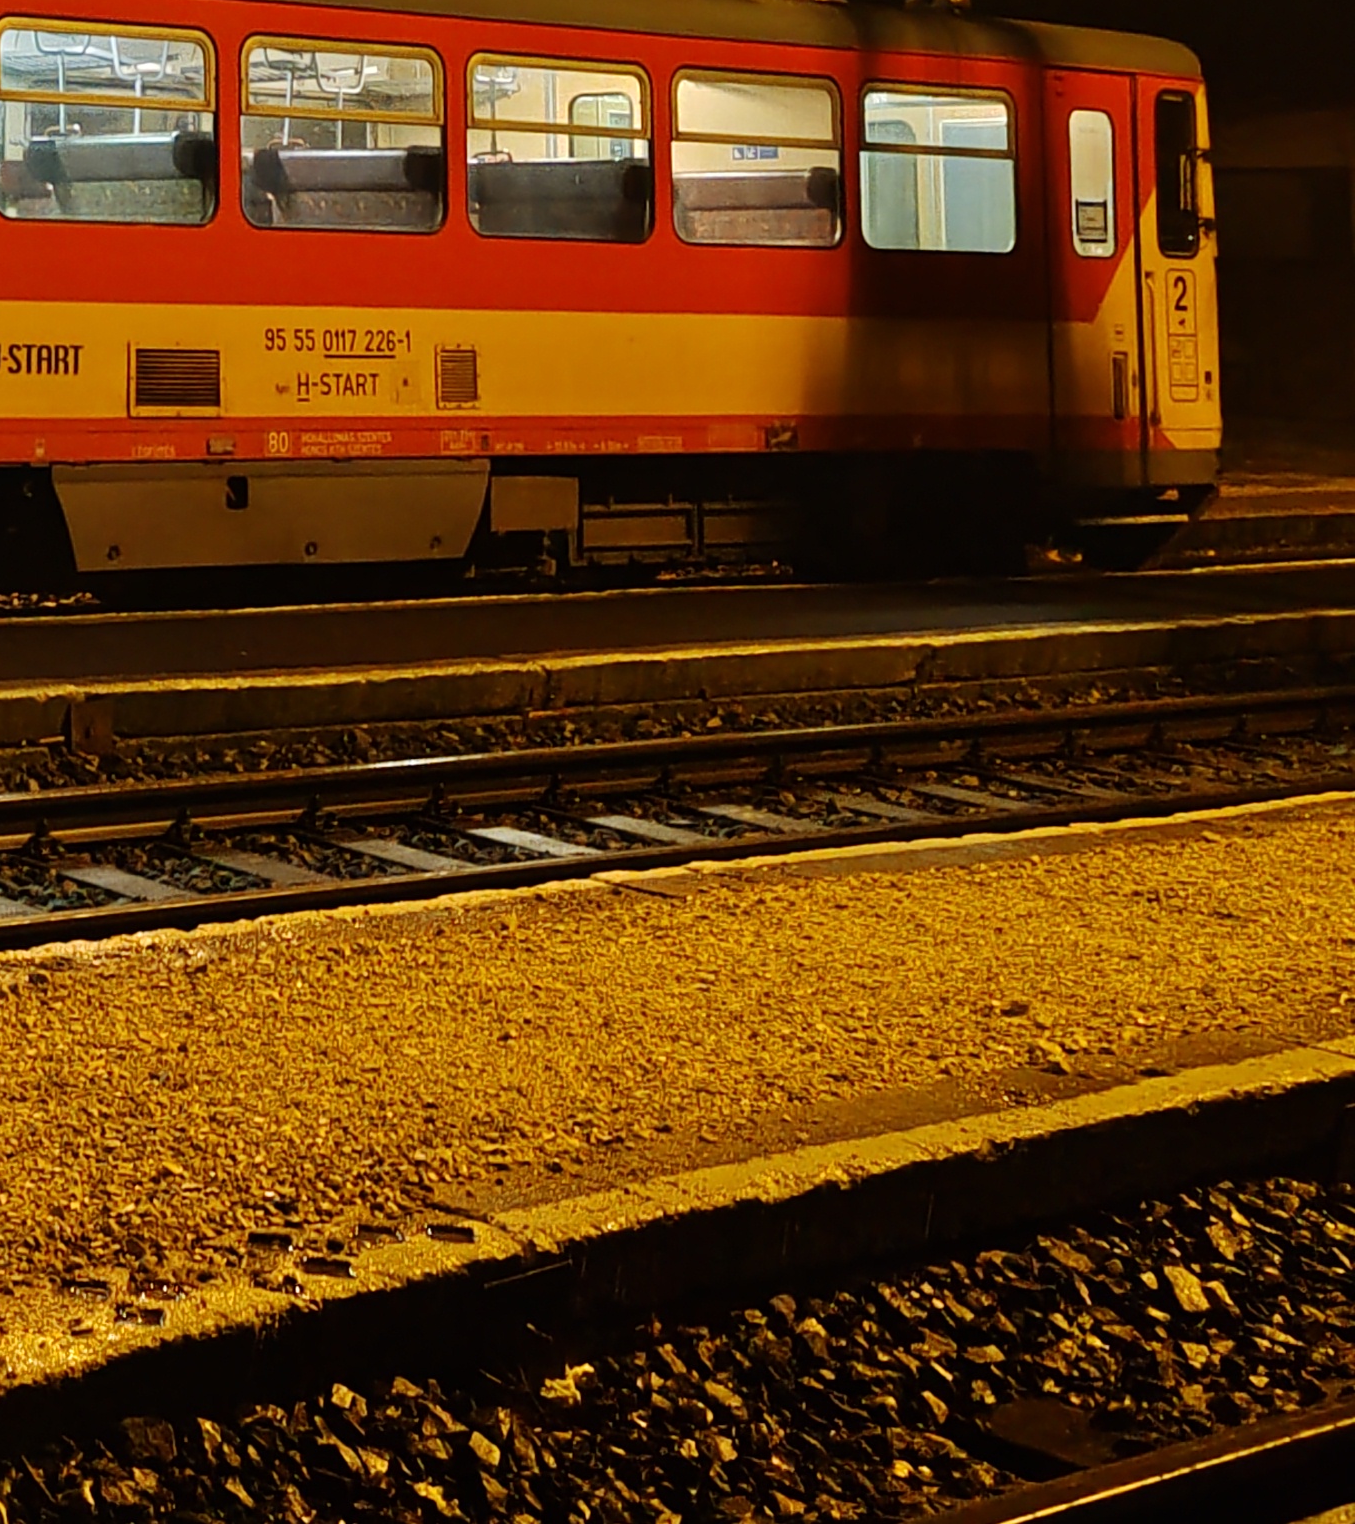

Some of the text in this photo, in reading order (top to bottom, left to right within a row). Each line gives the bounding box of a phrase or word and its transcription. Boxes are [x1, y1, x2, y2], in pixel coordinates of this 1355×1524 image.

[1174, 276, 1188, 311] 2
[264, 328, 411, 354] 95 55 0117 226-1
[297, 372, 380, 397] H-START
[268, 431, 289, 453] 80
